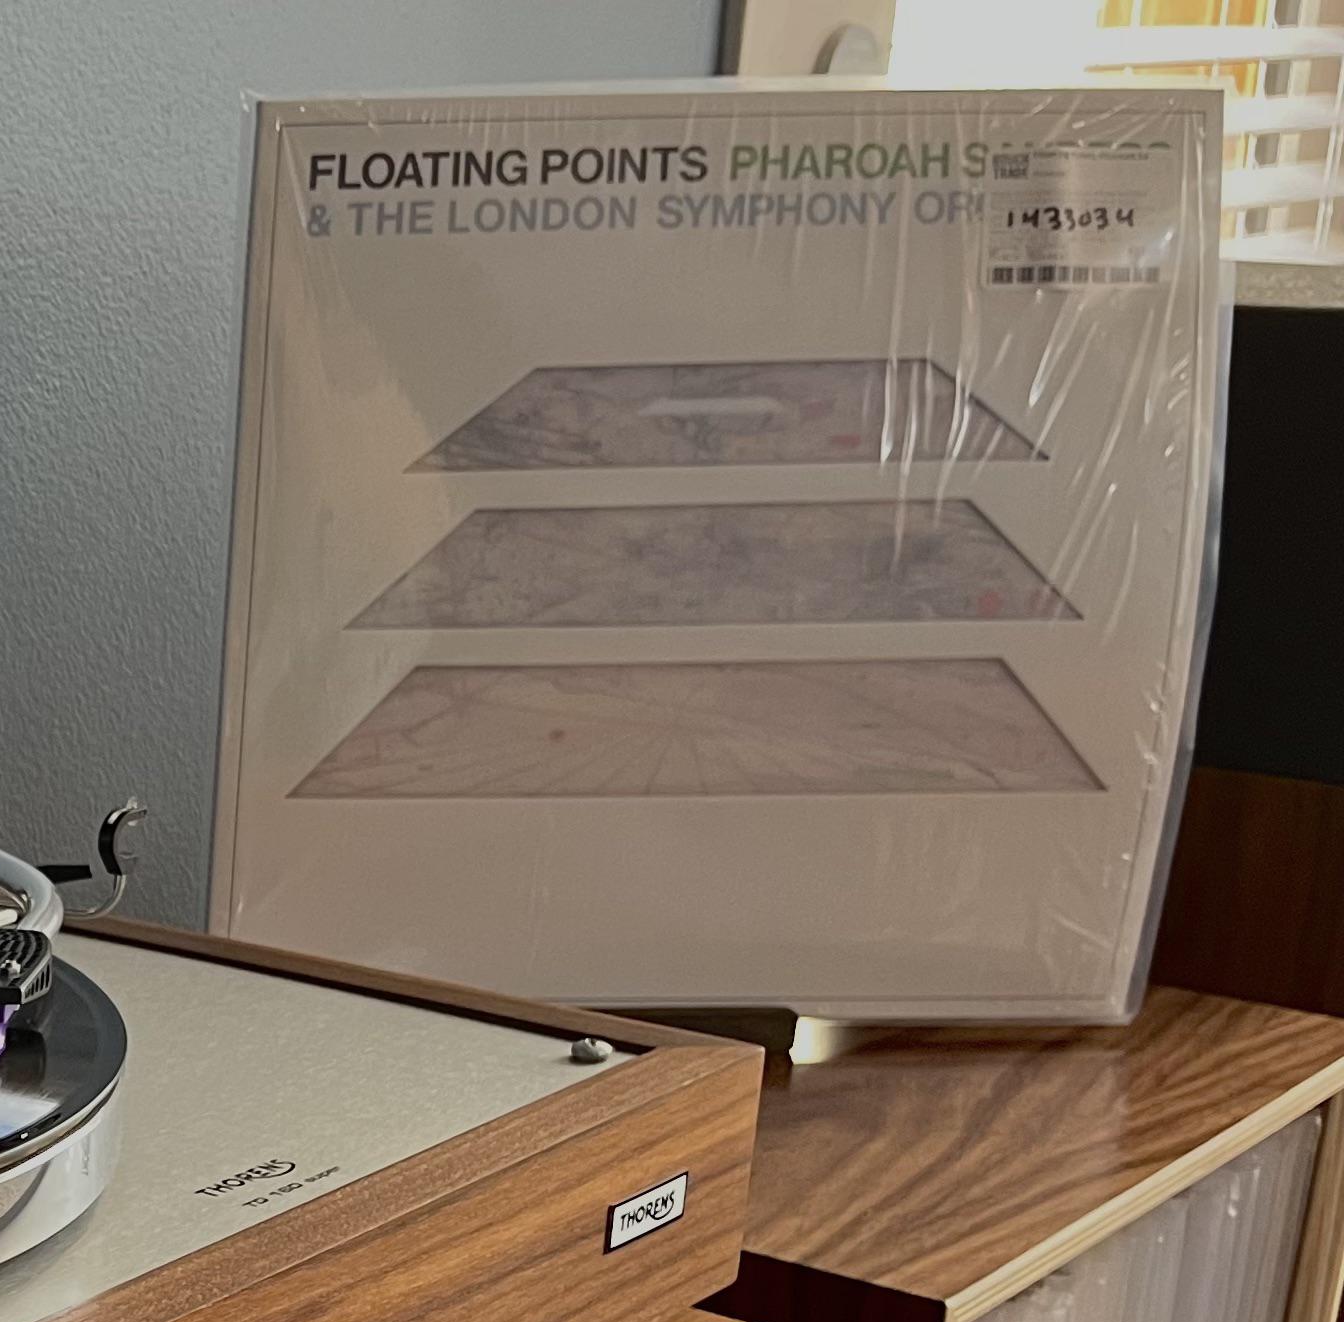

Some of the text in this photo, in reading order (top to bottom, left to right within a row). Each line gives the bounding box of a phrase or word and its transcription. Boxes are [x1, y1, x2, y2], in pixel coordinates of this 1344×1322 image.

[309, 149, 529, 191] FLOATING
[540, 146, 708, 185] POINTS
[730, 143, 950, 181] PHAROAH
[306, 203, 332, 237] &
[346, 200, 435, 236] THE
[448, 195, 637, 234] LONDON
[657, 191, 896, 229] SYMPHONY
[194, 1158, 297, 1198] THORENS
[620, 1190, 676, 1232] THORENS
